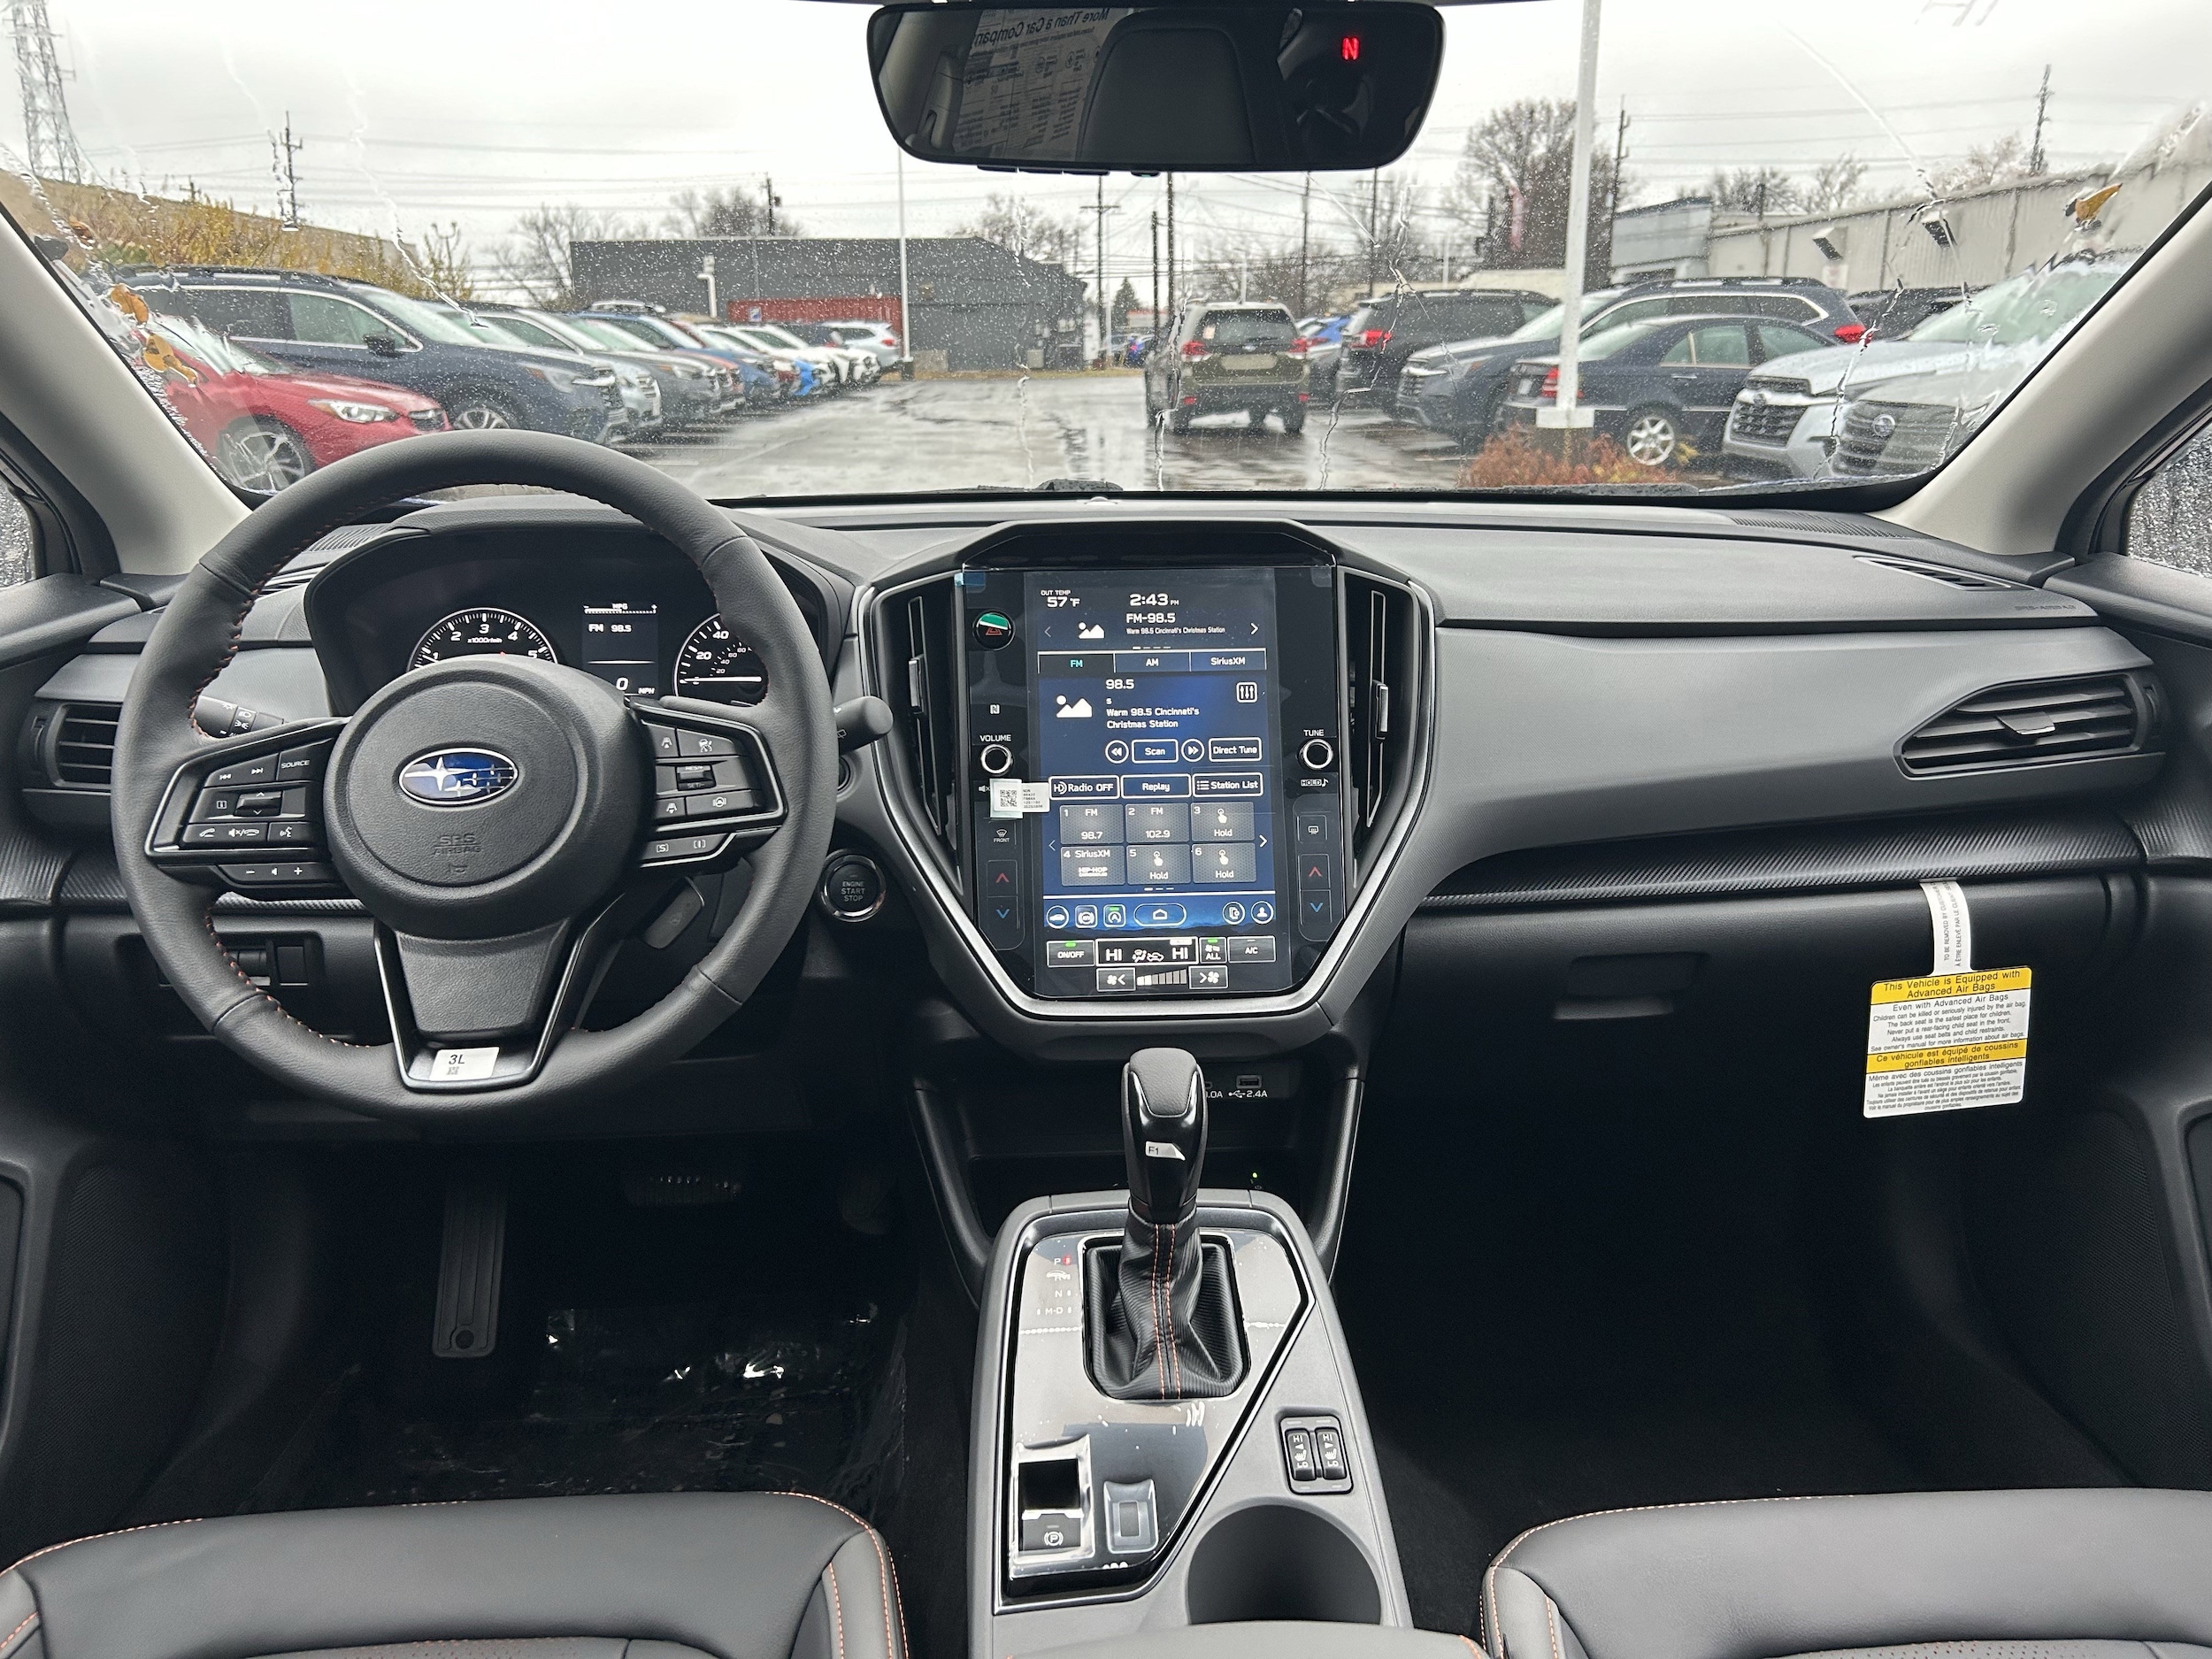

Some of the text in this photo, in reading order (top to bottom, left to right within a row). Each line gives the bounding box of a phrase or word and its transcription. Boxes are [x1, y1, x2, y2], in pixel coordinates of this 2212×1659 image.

[1342, 37, 1359, 61] N
[1047, 596, 1069, 608] 57
[1129, 593, 1169, 606] 2:43
[1125, 612, 1176, 624] FM-98.5
[480, 624, 490, 634] 3
[588, 624, 604, 633] FM
[450, 631, 462, 641] 2
[507, 631, 518, 641] 4
[712, 630, 730, 640] 40
[527, 649, 538, 659] 5
[695, 651, 712, 661] 20
[1070, 659, 1083, 668] FM
[1146, 657, 1159, 667] AM
[1210, 657, 1246, 666] SiriusXM
[616, 677, 629, 691] 0
[1105, 679, 1135, 690] 98.5
[1130, 708, 1153, 717] 98.5
[1106, 719, 1179, 729] Christmas Station
[1145, 747, 1166, 757] Scan
[1212, 745, 1258, 755] Direct Tune
[281, 759, 310, 770] SOURCE
[1068, 782, 1114, 793] Radio OFF
[1142, 782, 1171, 794] Replay
[1210, 780, 1259, 791] Station List
[1064, 809, 1069, 818] 1
[1085, 808, 1099, 818] FM
[1128, 807, 1135, 817] 2
[1150, 806, 1164, 816] FM
[1193, 806, 1201, 815] 3
[1080, 831, 1103, 841] 98.7
[1145, 829, 1171, 839] 102.9
[1213, 828, 1233, 838] Hold
[1074, 849, 1111, 858] SiriusXM
[1129, 849, 1137, 857] 5
[1194, 847, 1202, 856] 6
[1149, 870, 1169, 880] Hold
[1215, 869, 1234, 879] Hold
[843, 894, 864, 902] STOP
[1057, 950, 1085, 960] ON/OFF
[1105, 949, 1123, 962] HI
[1171, 947, 1189, 960] HI
[1907, 979, 1940, 988] Vehicle
[1955, 972, 1999, 985] Equipped
[2001, 970, 2020, 979] with
[1907, 983, 1996, 999] Advanced Air Bags
[1933, 997, 1972, 1008] Advanced
[1989, 994, 2008, 1002] Bags
[1941, 1007, 1965, 1016] seriously
[1967, 1004, 1985, 1013] injured
[1891, 1051, 1924, 1061] véhicule
[1941, 1046, 1969, 1056] équipé
[1984, 1042, 2018, 1051] coussins
[1904, 1053, 1990, 1069] gonflables intelligents
[1954, 1064, 1986, 1074] gonflables
[1989, 1061, 2024, 1071] intelligents
[1148, 1146, 1159, 1156] F1
[1293, 1434, 1303, 1443] HI
